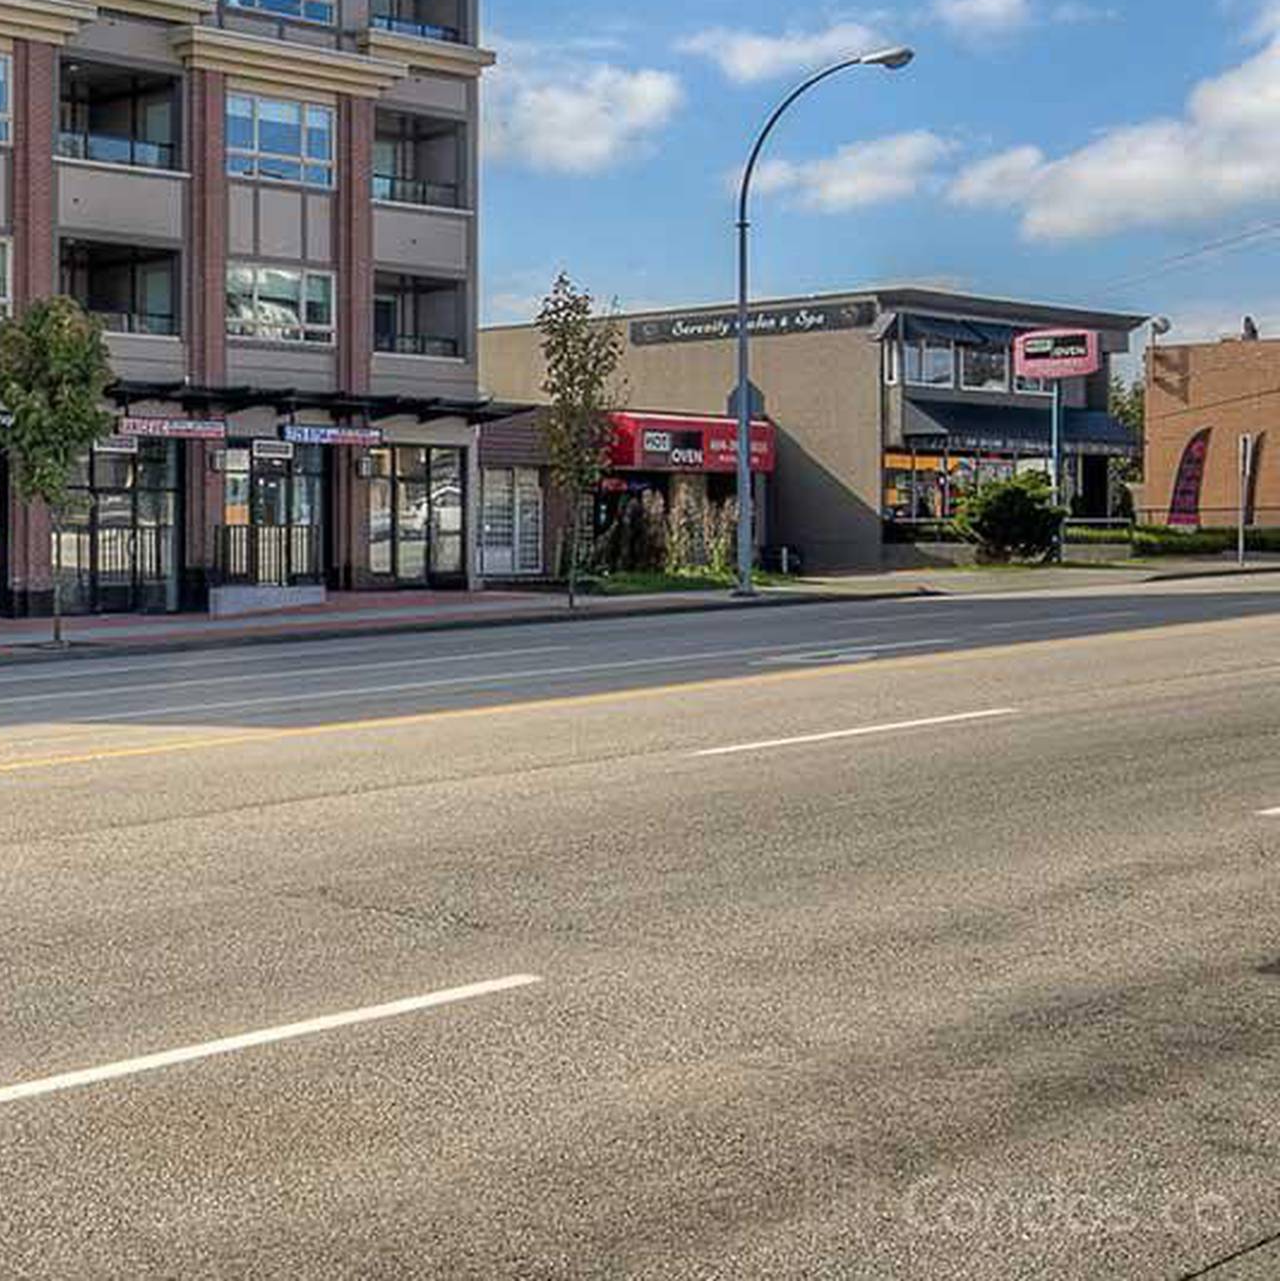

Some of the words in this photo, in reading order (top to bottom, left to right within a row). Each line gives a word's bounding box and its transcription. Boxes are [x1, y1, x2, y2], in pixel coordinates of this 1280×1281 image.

[671, 319, 731, 338] Serenity
[735, 312, 776, 333] alon
[795, 310, 825, 330] Spa
